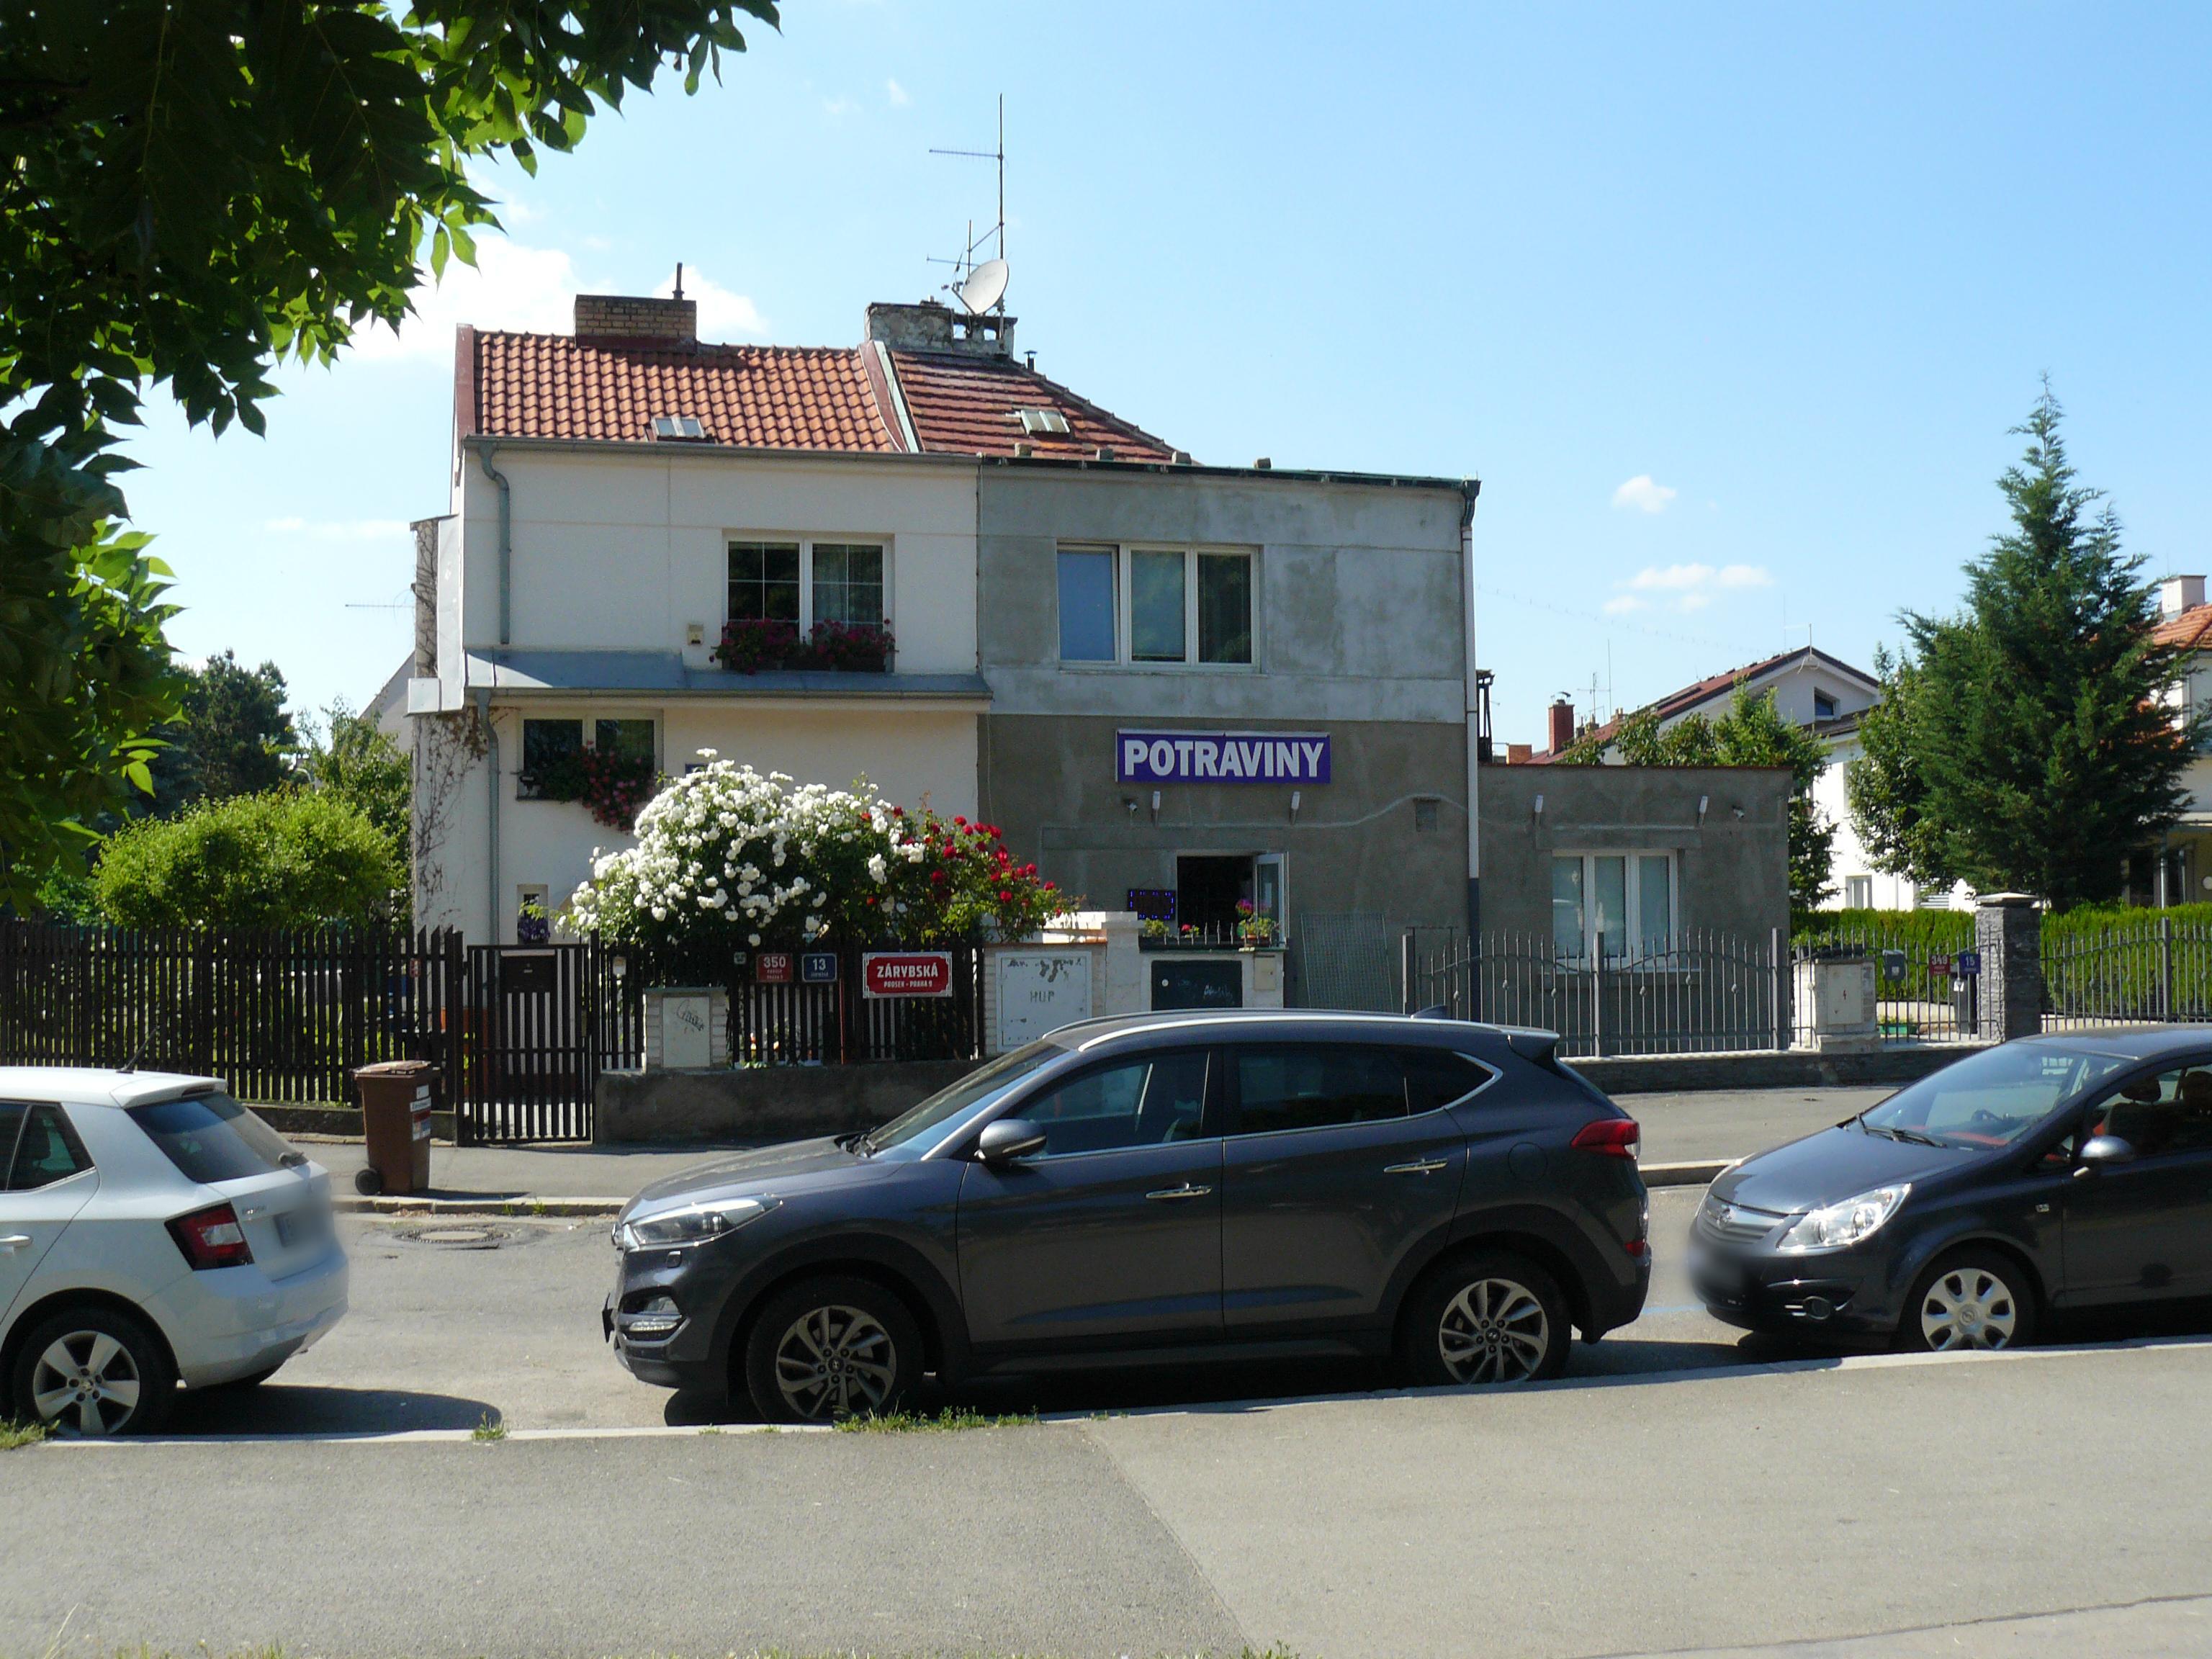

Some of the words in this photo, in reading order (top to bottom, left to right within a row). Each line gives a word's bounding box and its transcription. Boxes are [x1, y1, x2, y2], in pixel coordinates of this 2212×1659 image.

[1125, 739, 1324, 778] POTRAVINY
[763, 956, 786, 968] 350
[812, 958, 826, 971] 13
[1965, 956, 1975, 966] 15
[876, 962, 938, 978] ZÁRYBSKÁ
[1030, 989, 1055, 1003] HUP
